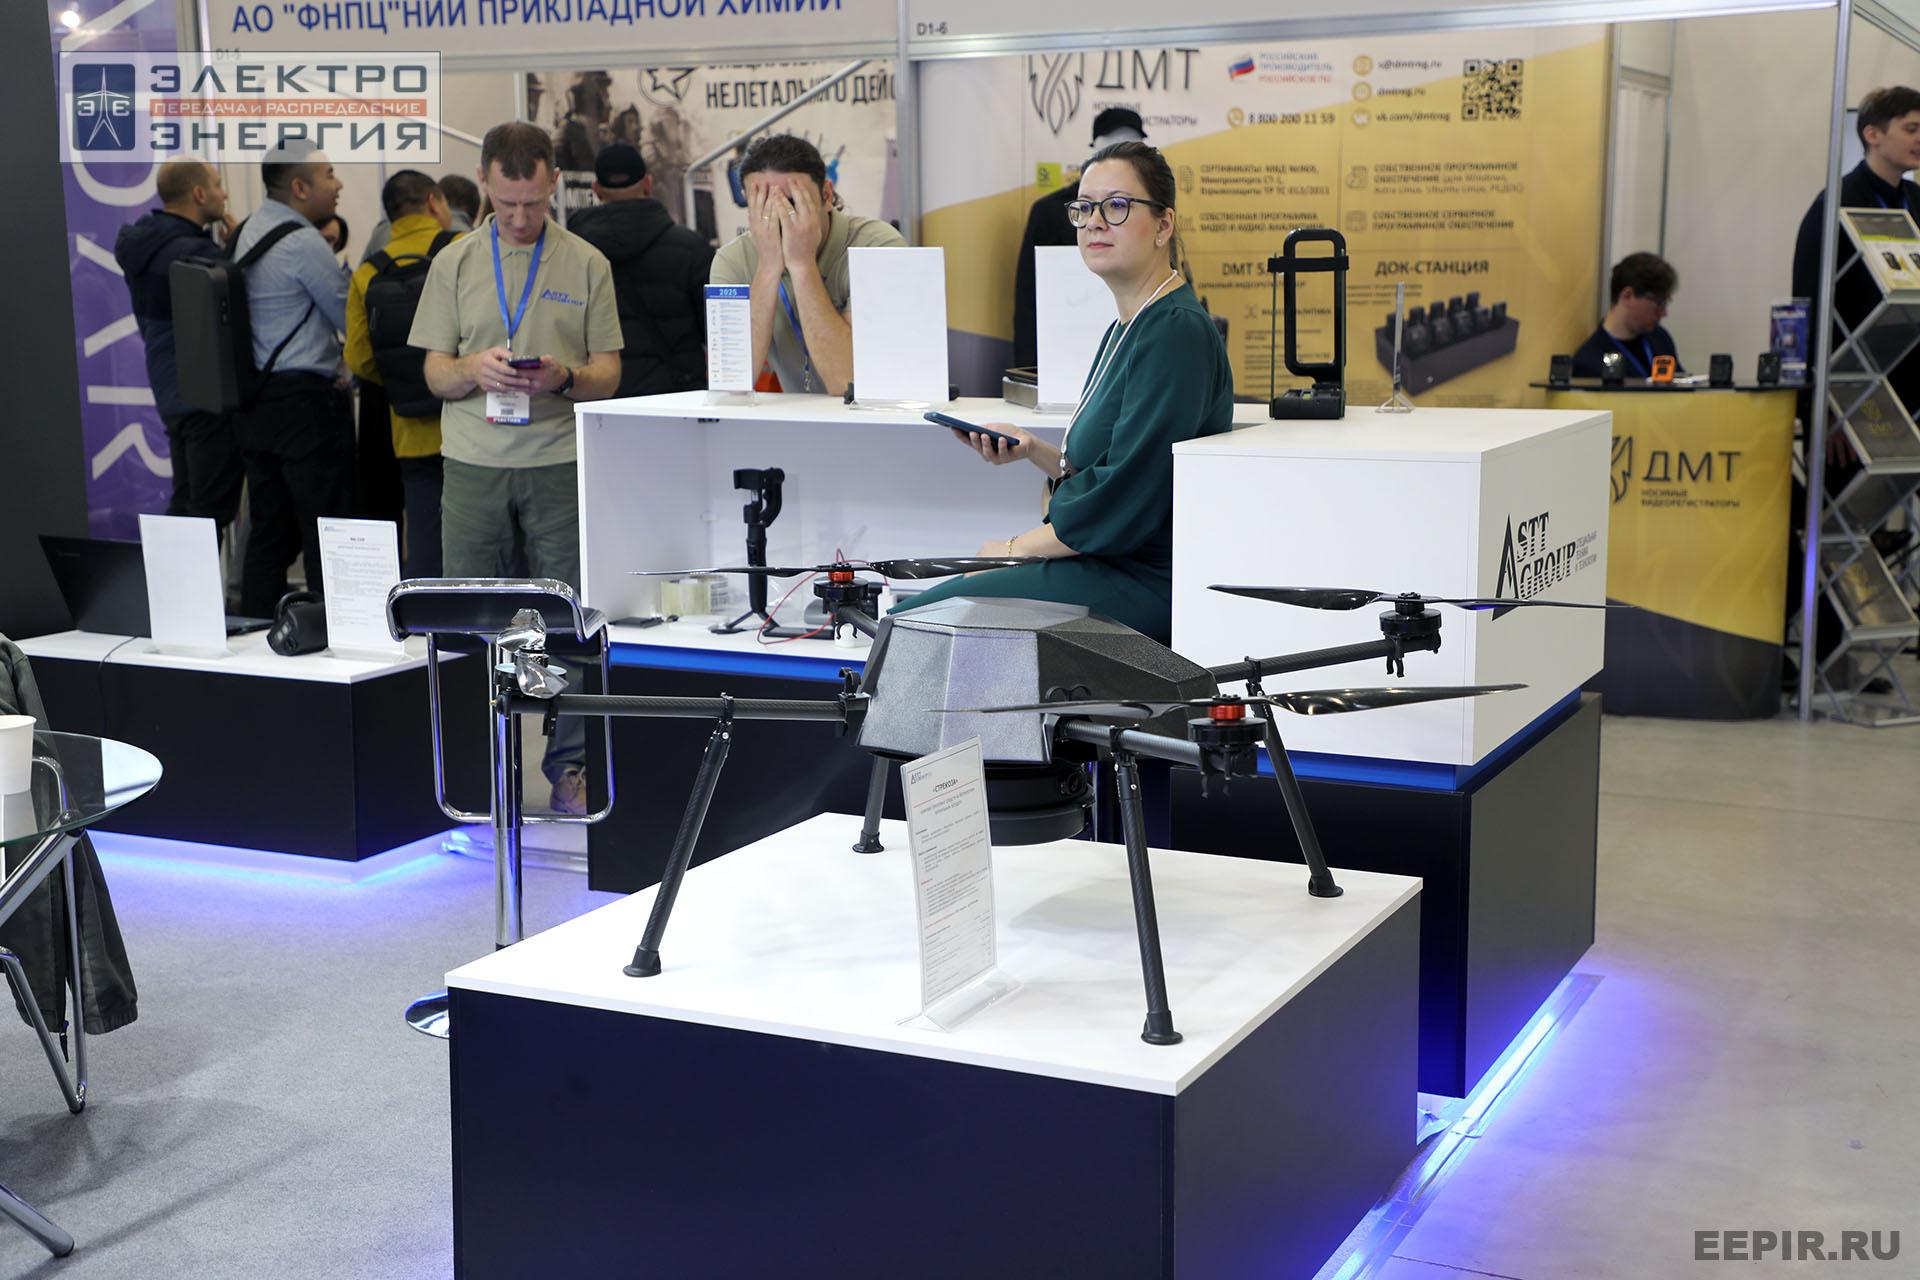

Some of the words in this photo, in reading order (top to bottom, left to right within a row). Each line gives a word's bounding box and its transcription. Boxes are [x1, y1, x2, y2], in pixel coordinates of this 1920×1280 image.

[232, 4, 273, 33] АО
[1095, 48, 1200, 90] ДМТ
[1304, 112, 1318, 125] 11
[1375, 260, 1490, 277] ДОК-СТАНЦИЯ
[718, 287, 738, 297] 2025
[1642, 450, 1742, 483] ДМТ
[1520, 541, 1577, 600] GROUP
